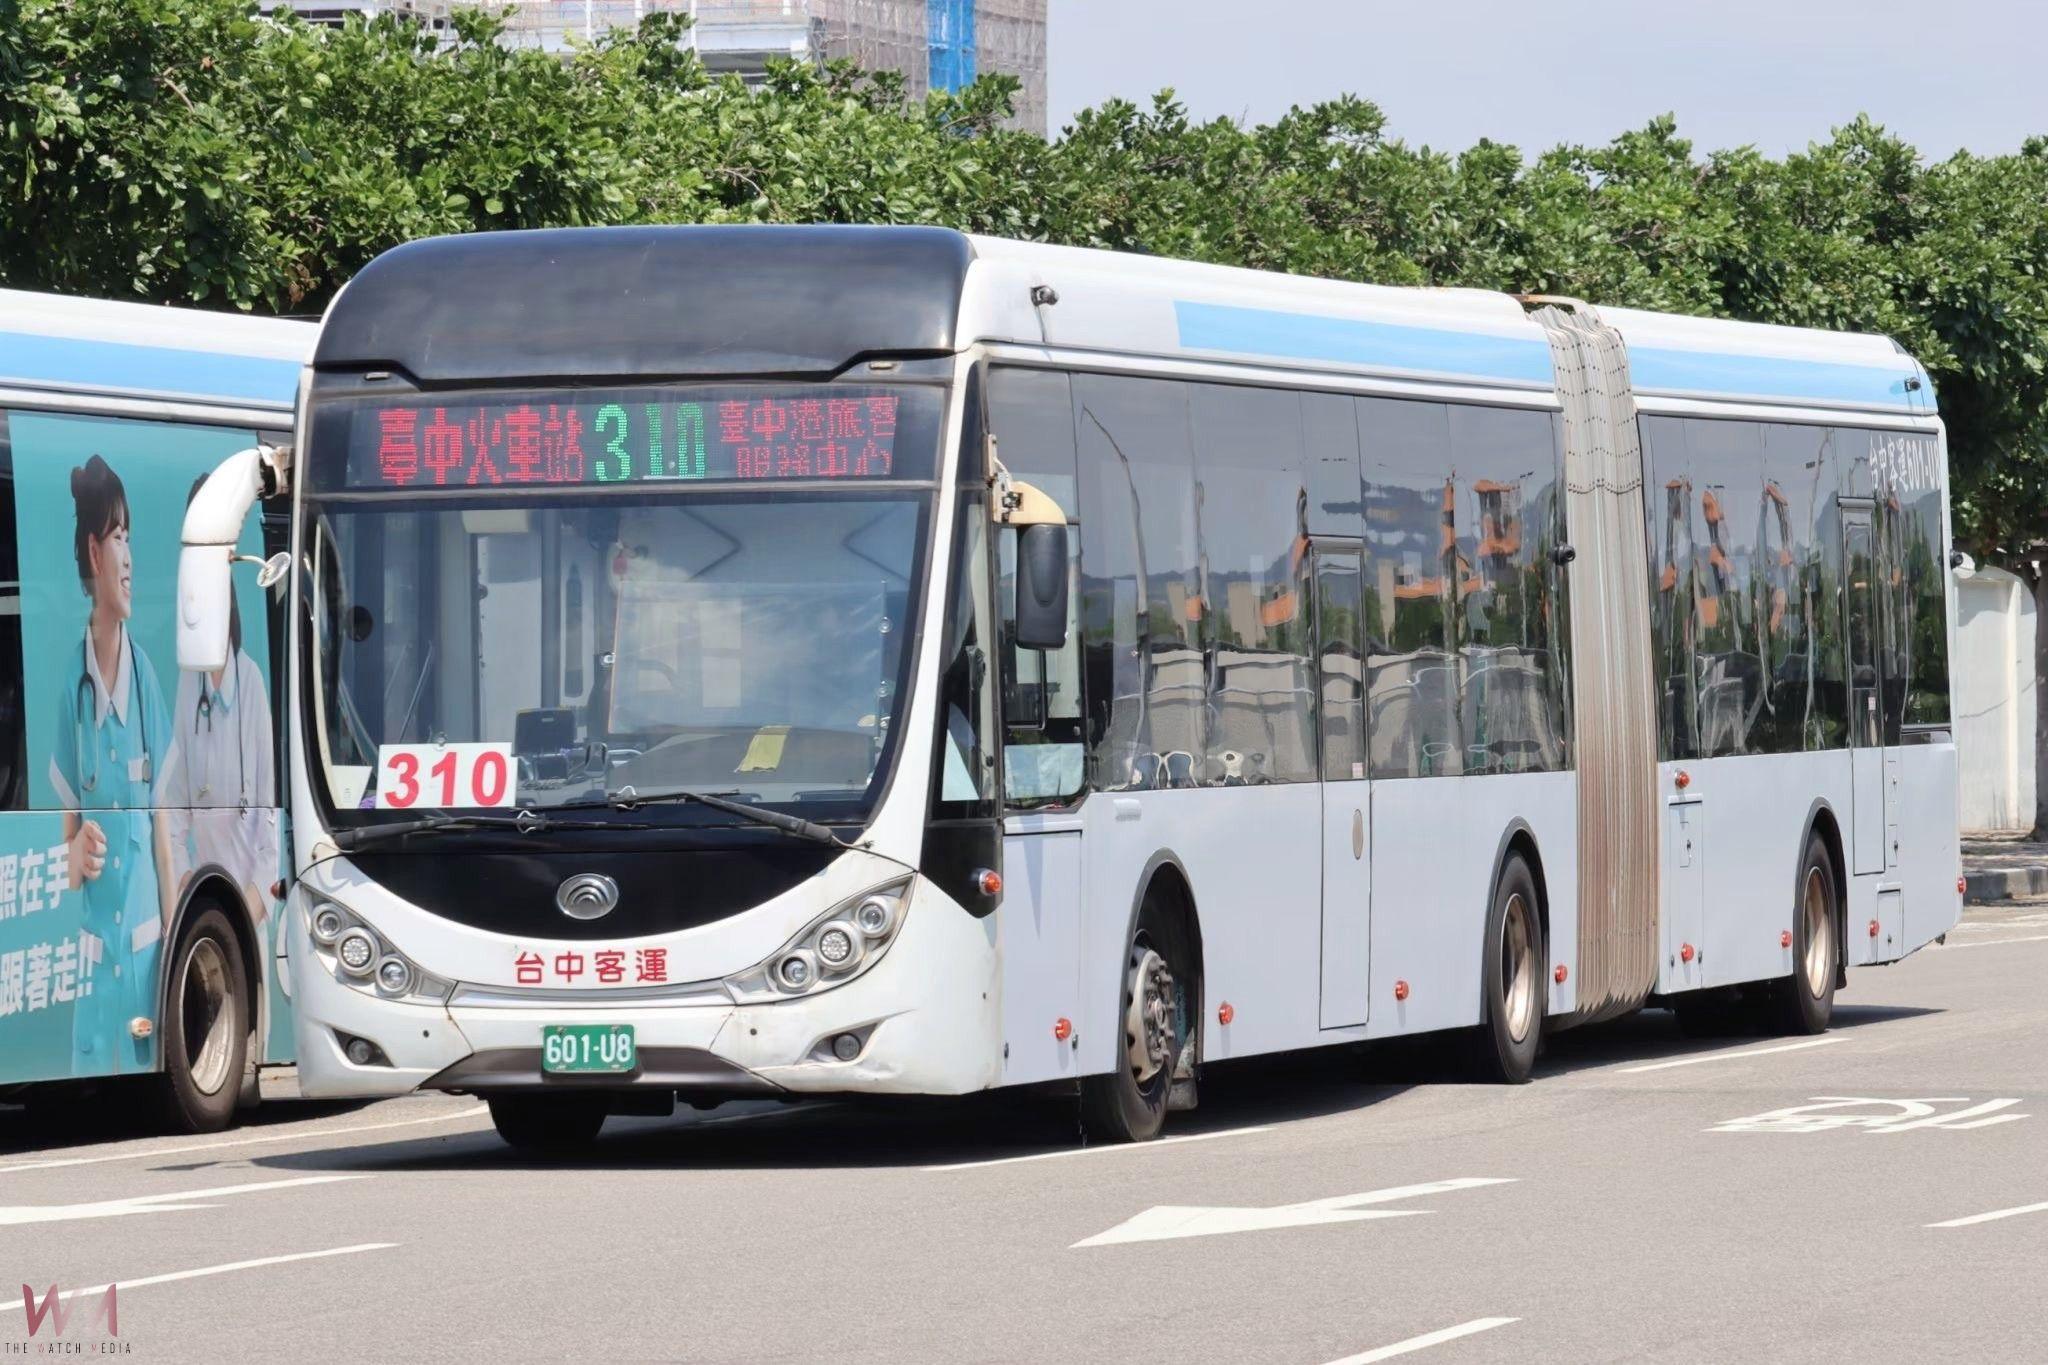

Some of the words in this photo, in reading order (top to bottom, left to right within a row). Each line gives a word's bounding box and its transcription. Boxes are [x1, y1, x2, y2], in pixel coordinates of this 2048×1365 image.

[594, 402, 706, 482] 310
[384, 750, 508, 809] 310
[514, 947, 668, 984] 台中客運
[546, 1032, 632, 1063] 601-U8
